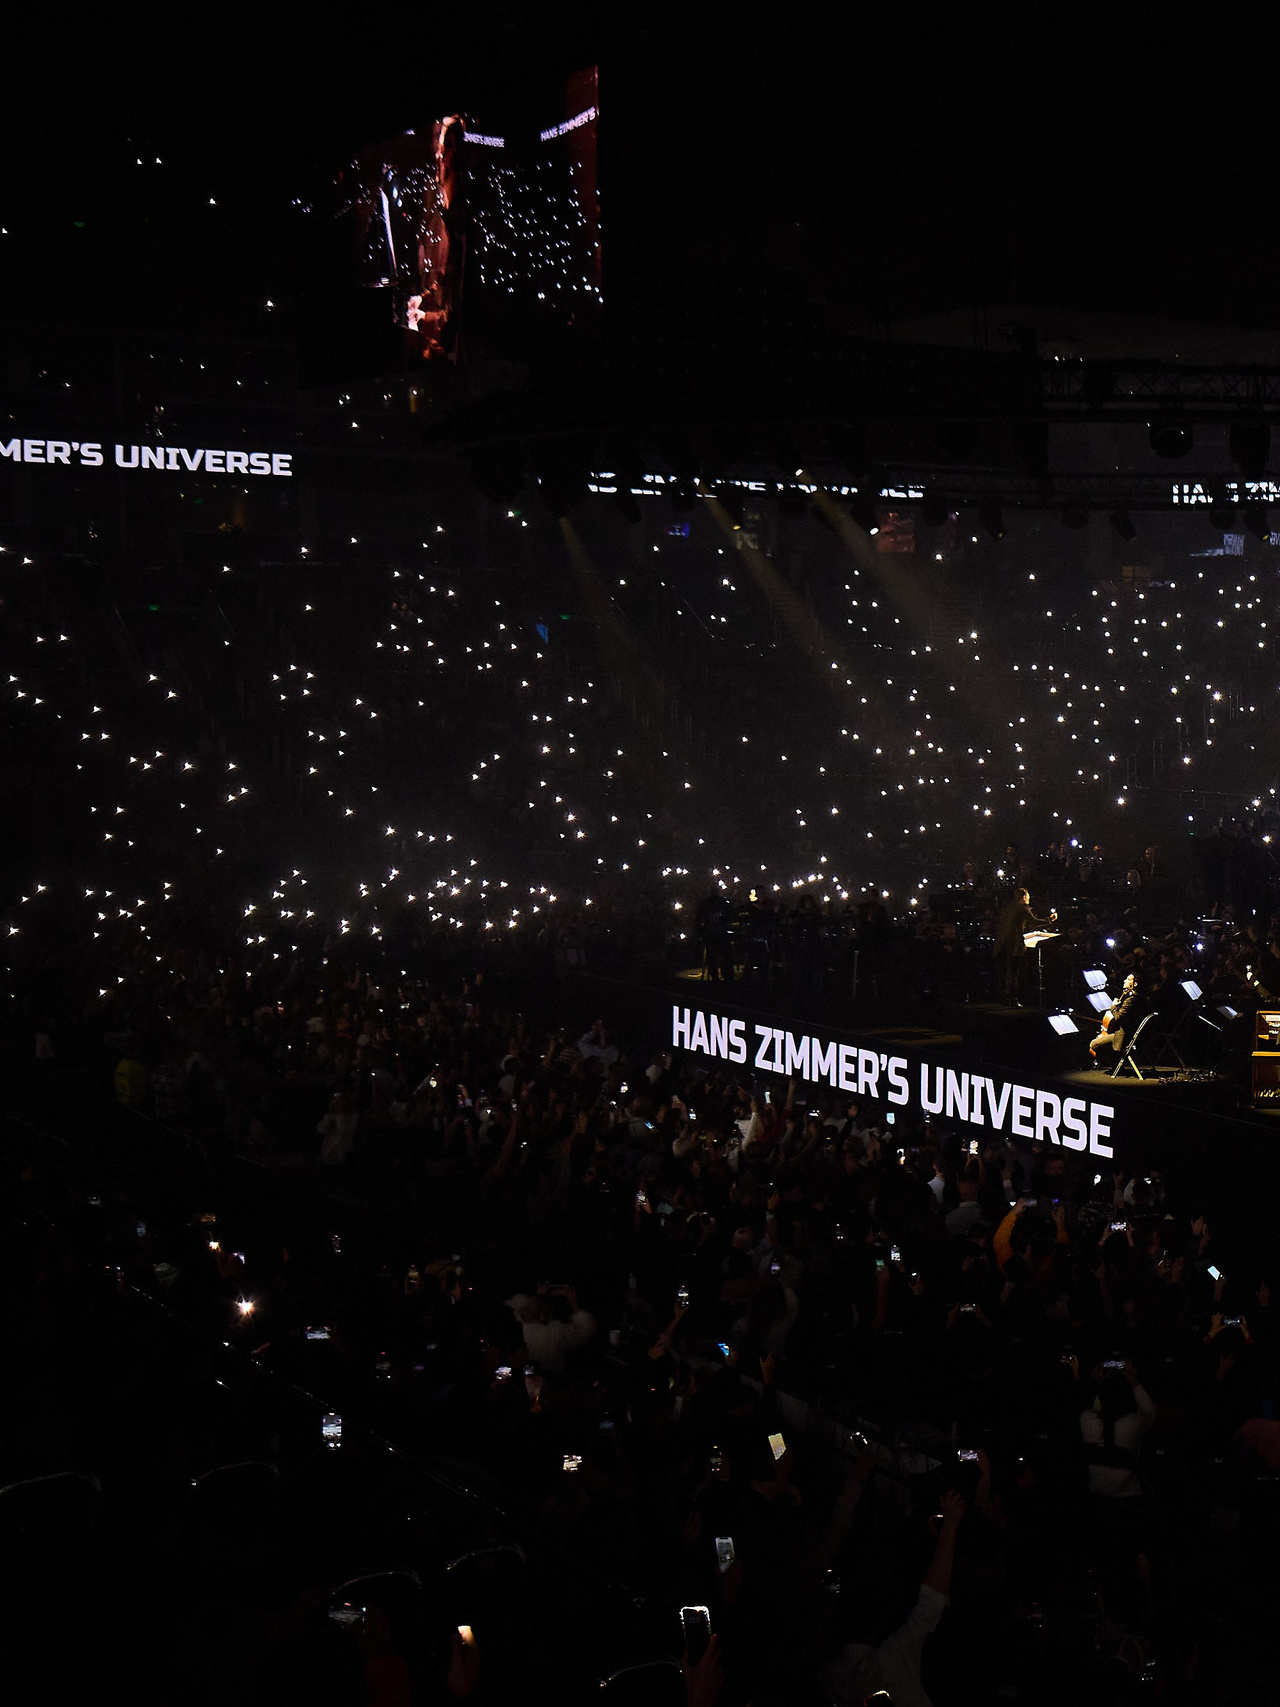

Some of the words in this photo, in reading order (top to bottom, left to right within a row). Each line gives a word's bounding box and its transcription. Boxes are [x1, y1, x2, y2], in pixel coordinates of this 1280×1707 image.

[115, 443, 293, 477] UNIVERSE
[672, 1005, 747, 1064] HANS
[754, 1024, 910, 1106] ZIMMER'S
[920, 1062, 1115, 1159] UNIVERSE
